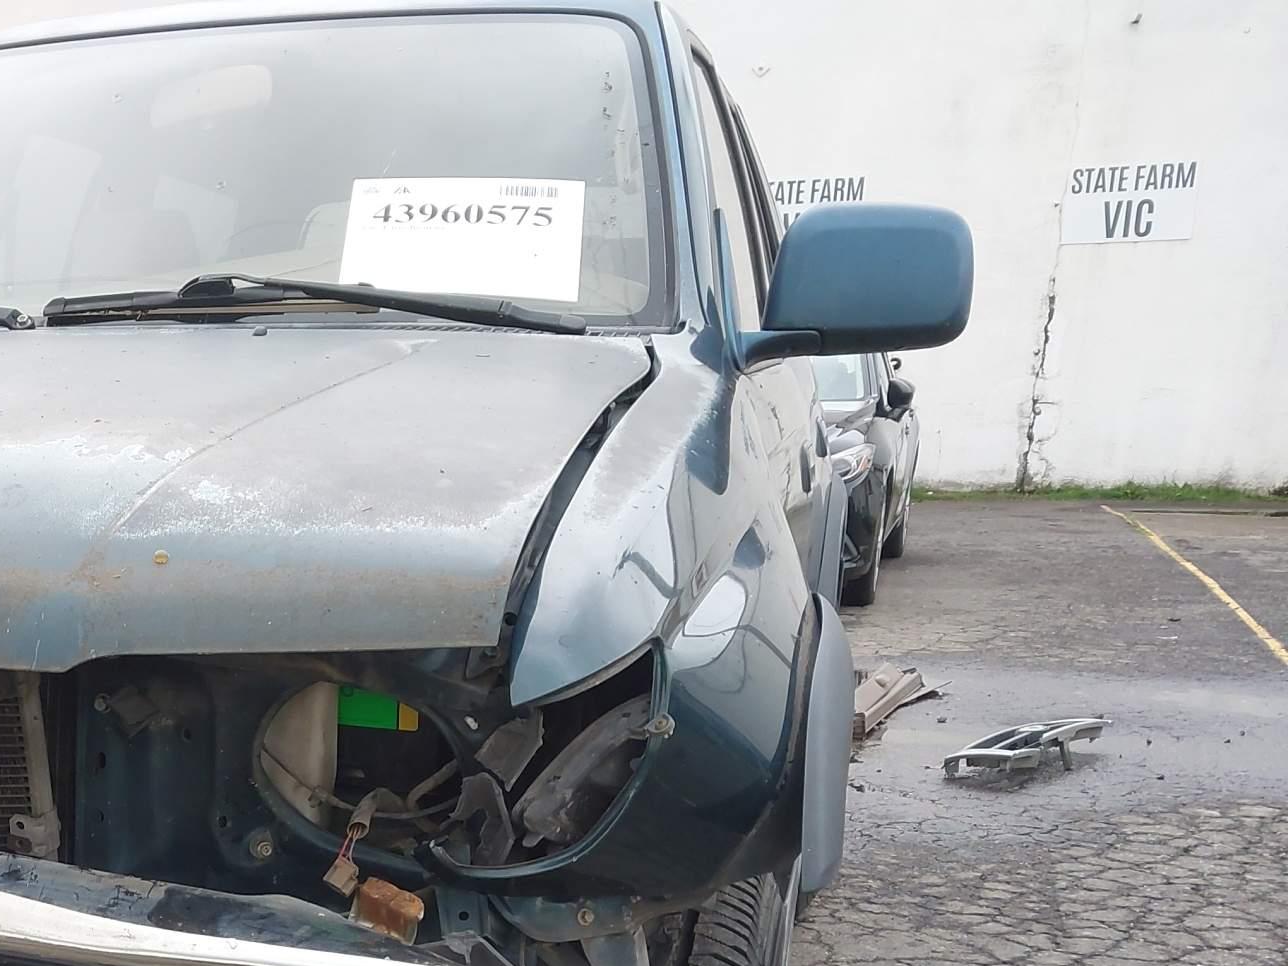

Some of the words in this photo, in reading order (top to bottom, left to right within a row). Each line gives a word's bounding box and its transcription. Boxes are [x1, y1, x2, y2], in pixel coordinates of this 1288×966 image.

[769, 180, 806, 205] ATE
[810, 176, 866, 204] FARM
[1071, 165, 1130, 194] STATE
[1134, 161, 1197, 191] FARM
[372, 203, 553, 227] 43960575
[1103, 198, 1155, 239] VIC
